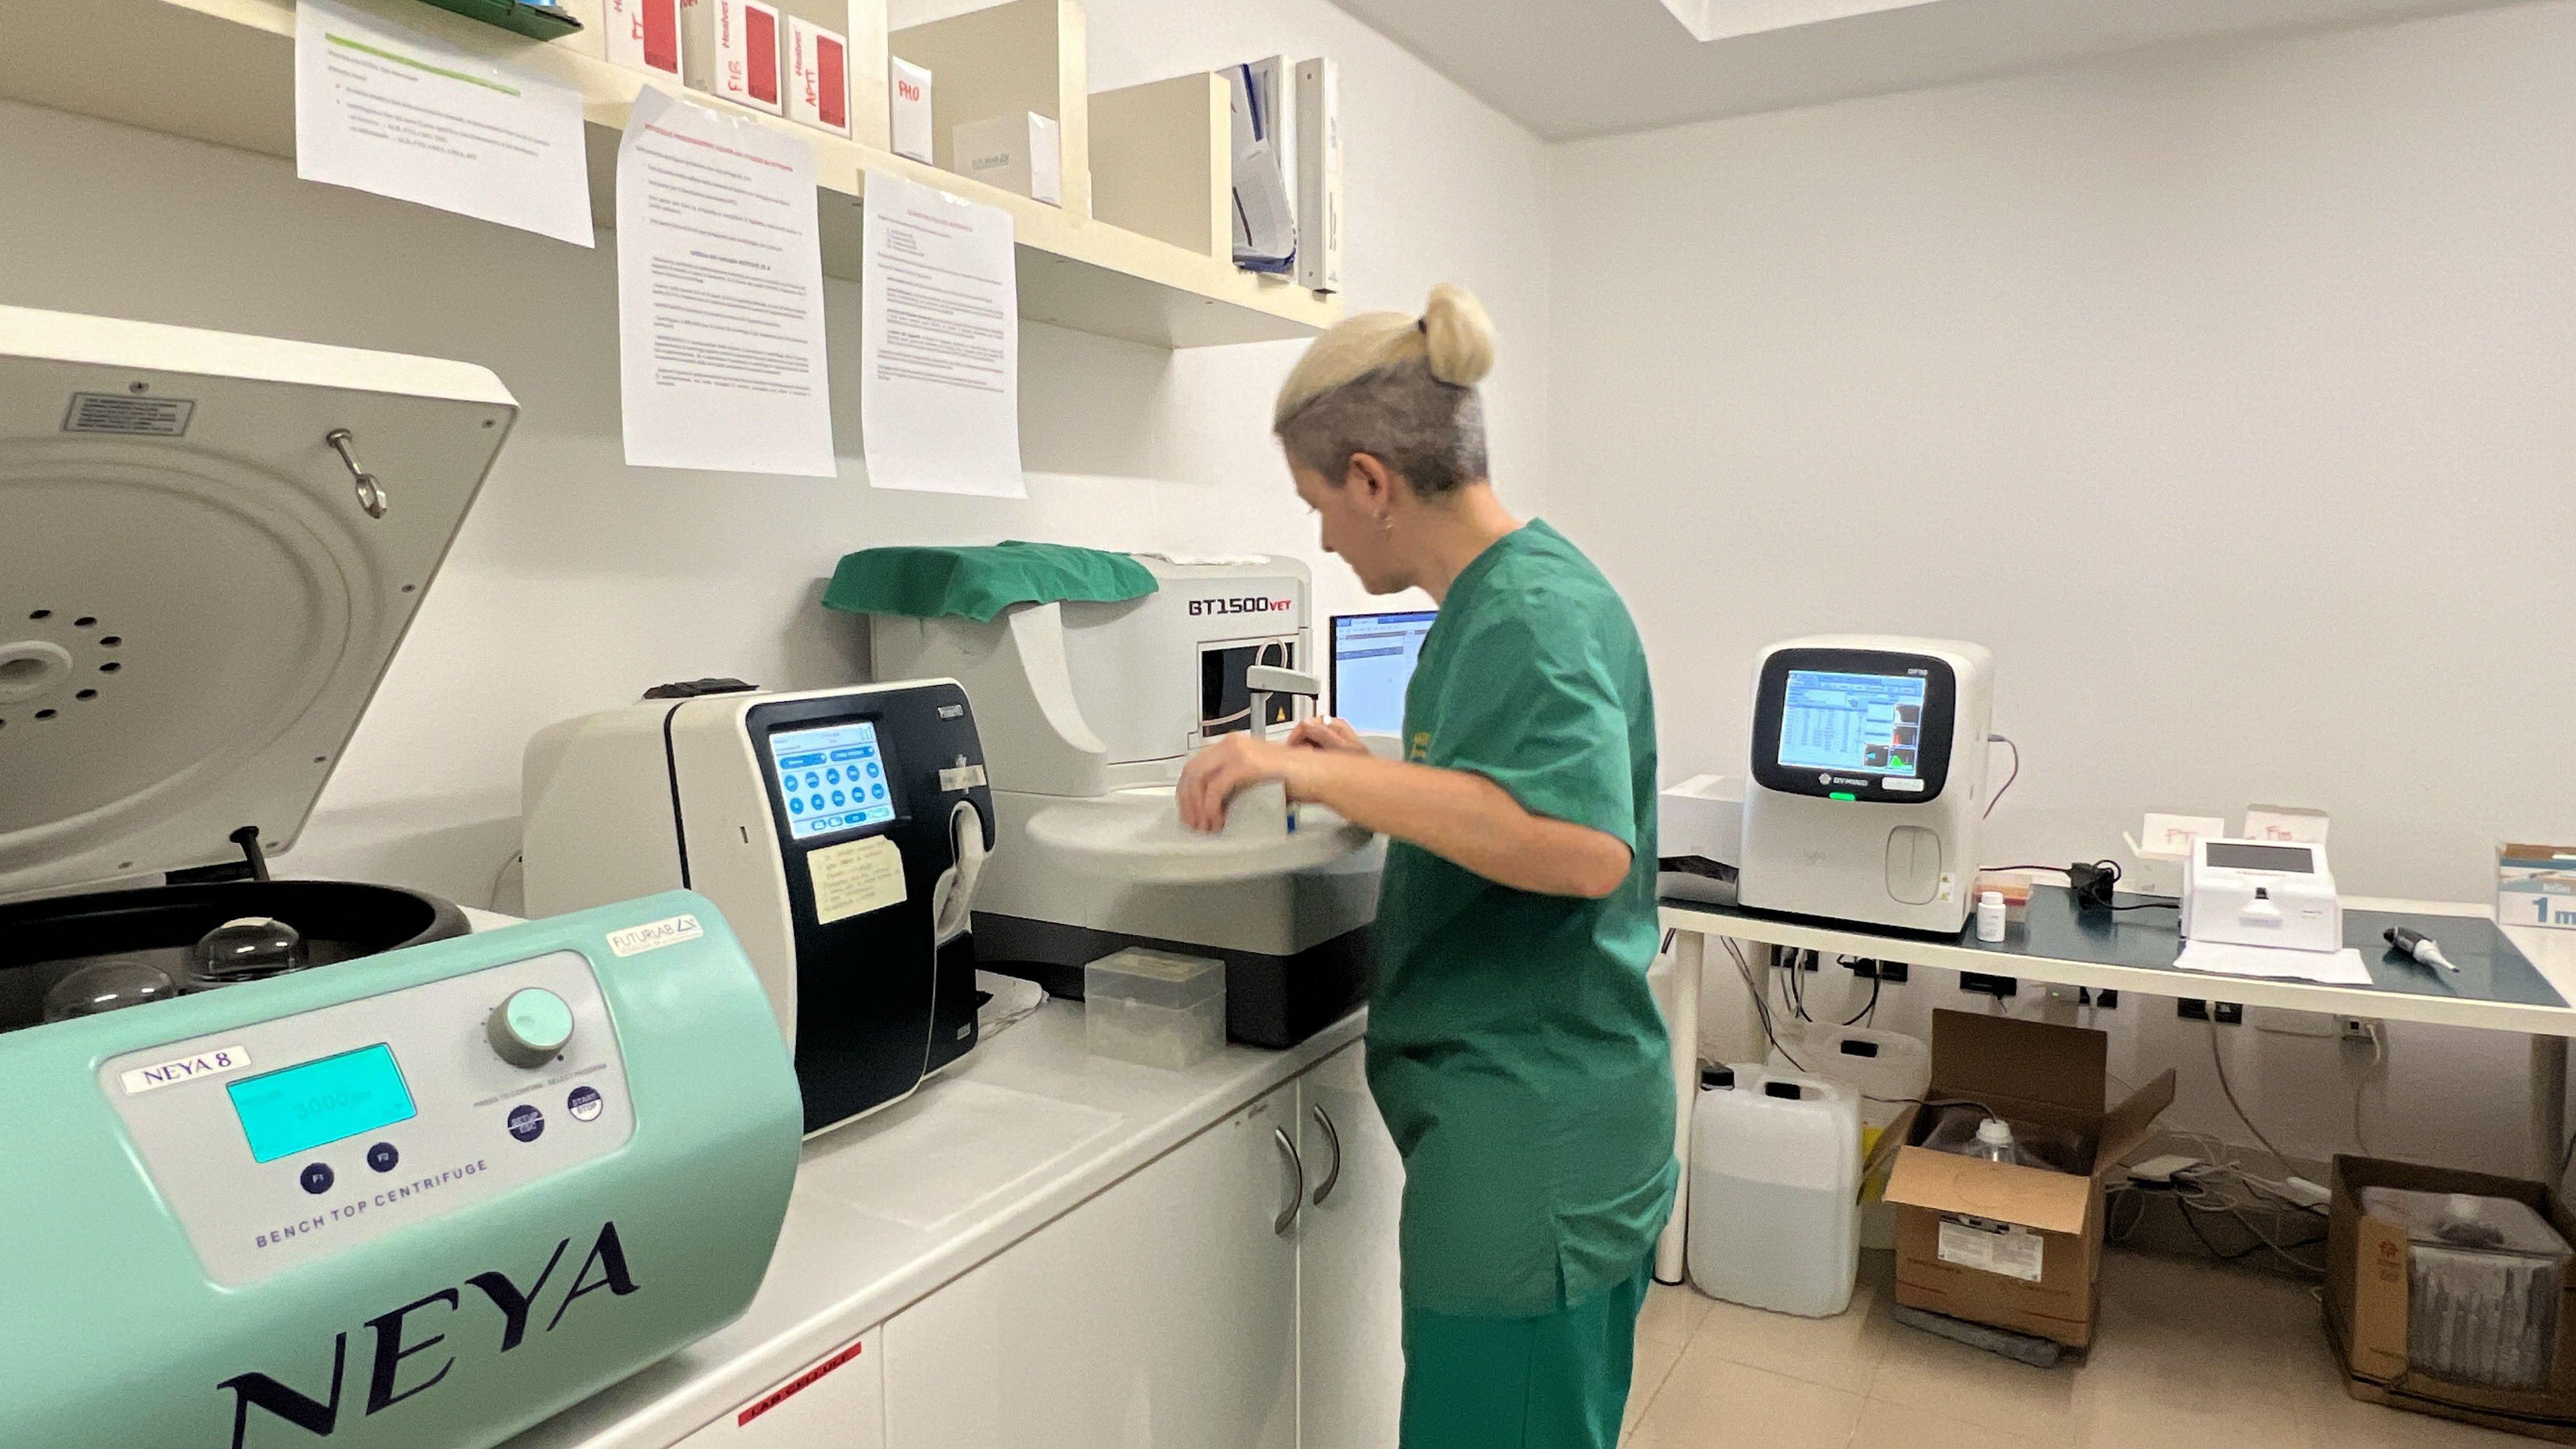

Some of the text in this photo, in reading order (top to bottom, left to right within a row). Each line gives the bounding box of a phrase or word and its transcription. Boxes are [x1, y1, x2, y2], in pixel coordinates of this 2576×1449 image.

[728, 60, 742, 91] FIB
[805, 68, 816, 107] APTT
[2532, 896, 2548, 923] 1
[142, 1052, 232, 1085] NEYA 8
[256, 1160, 487, 1248] BENCH TOP CENTRIFUGE
[217, 1221, 640, 1449] NEYA
